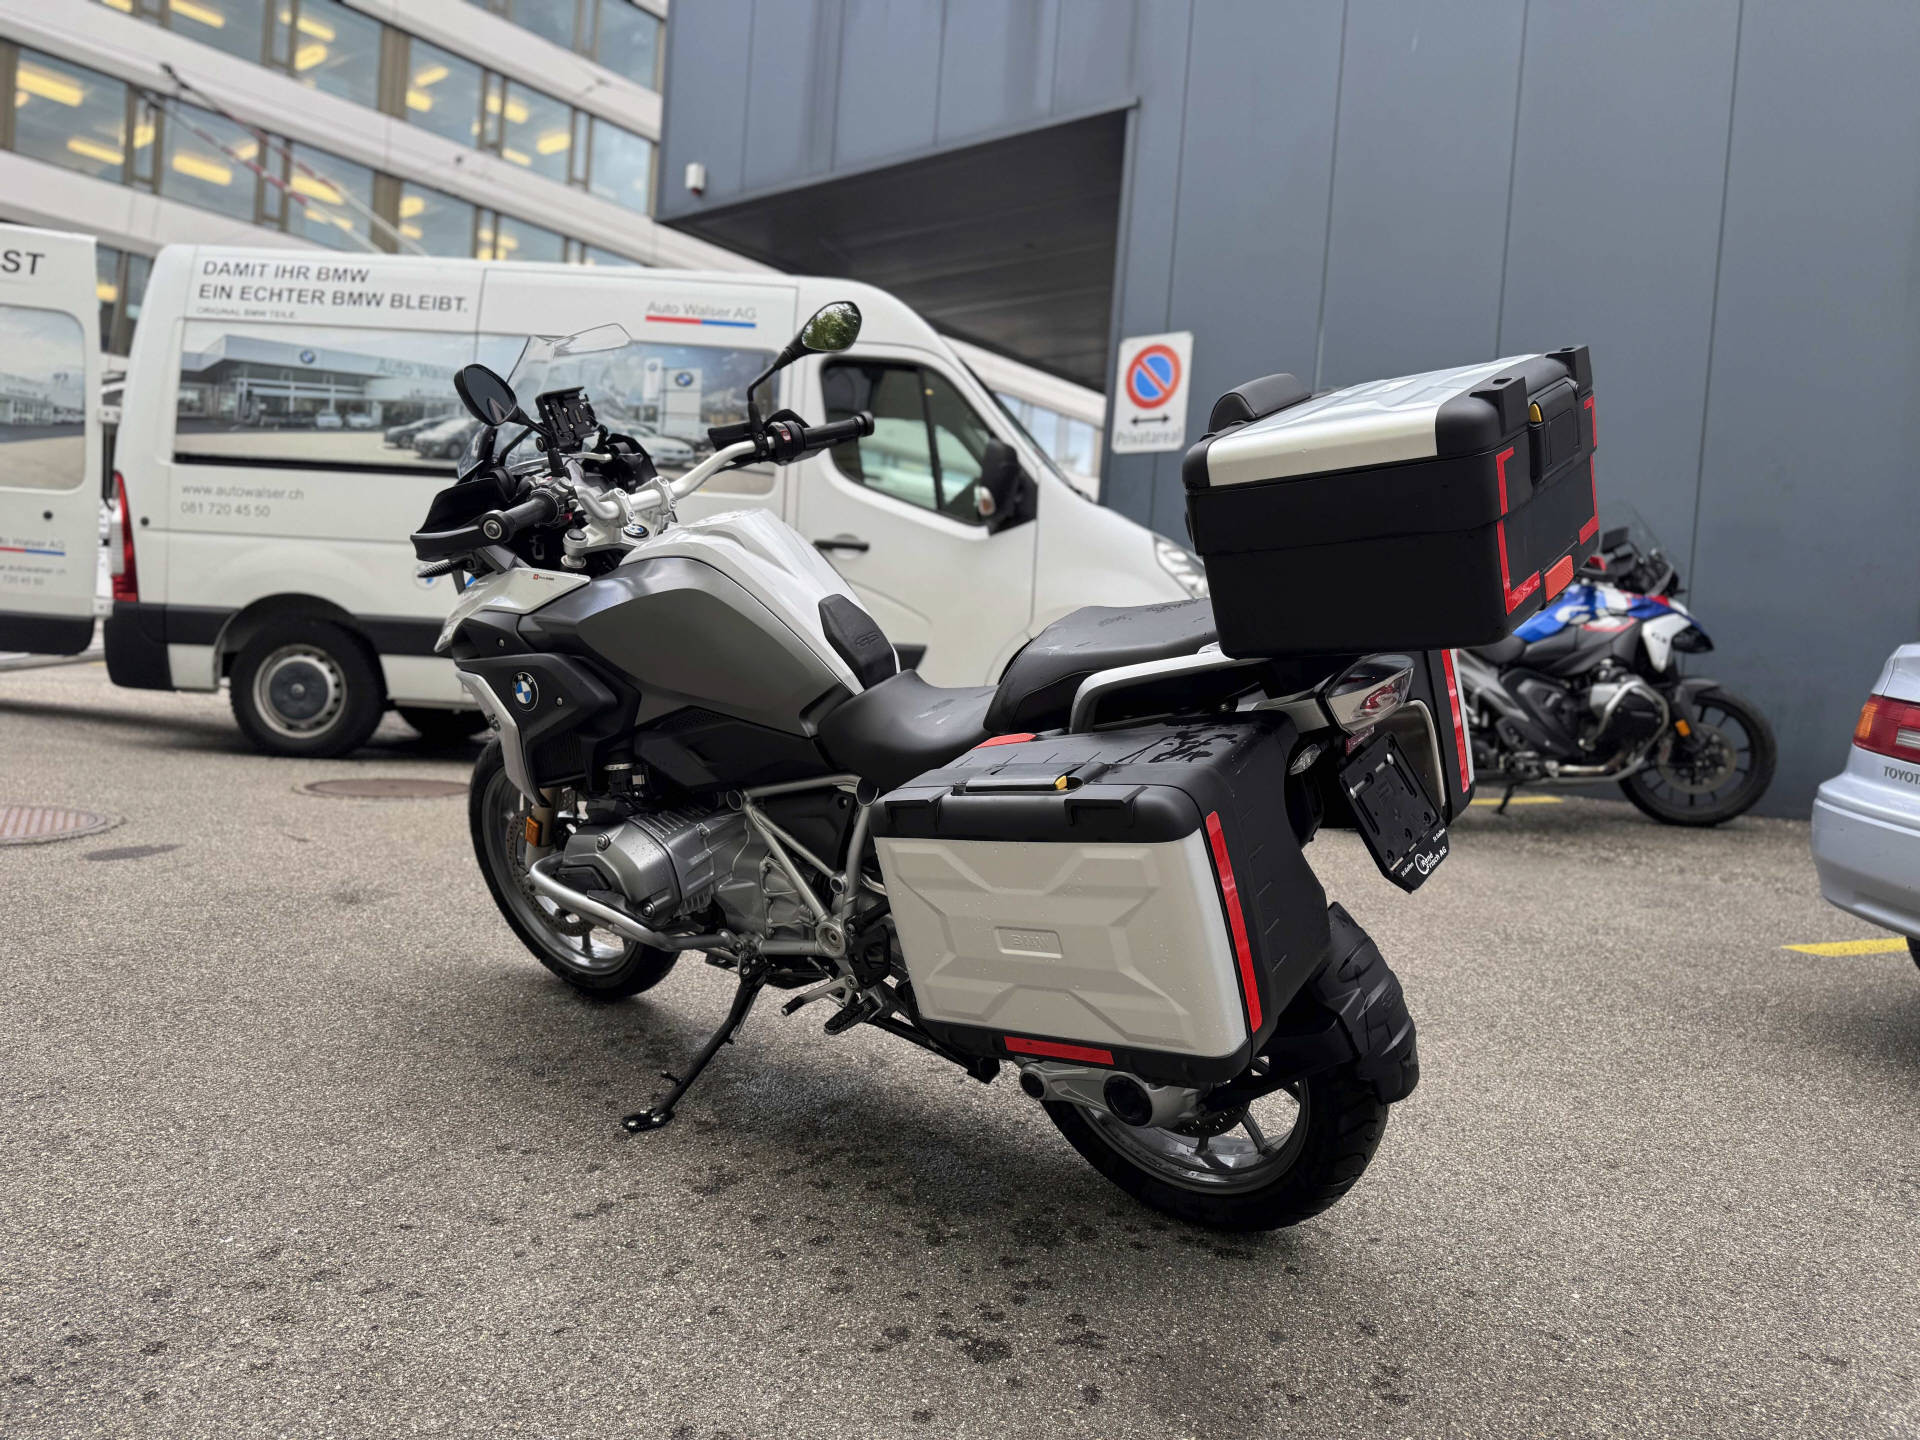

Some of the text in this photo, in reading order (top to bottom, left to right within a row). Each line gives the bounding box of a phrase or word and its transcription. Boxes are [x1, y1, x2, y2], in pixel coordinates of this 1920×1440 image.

[202, 260, 370, 283] DAMIT IHR BMW
[198, 283, 468, 313] EIN ECHTER BMW BLEIBT.
[647, 300, 680, 313] Auto
[735, 309, 757, 320] AG
[182, 485, 304, 500] www.autowalser.ch
[180, 500, 272, 518] 081 720 45 50
[1884, 766, 1920, 785] TOYOT
